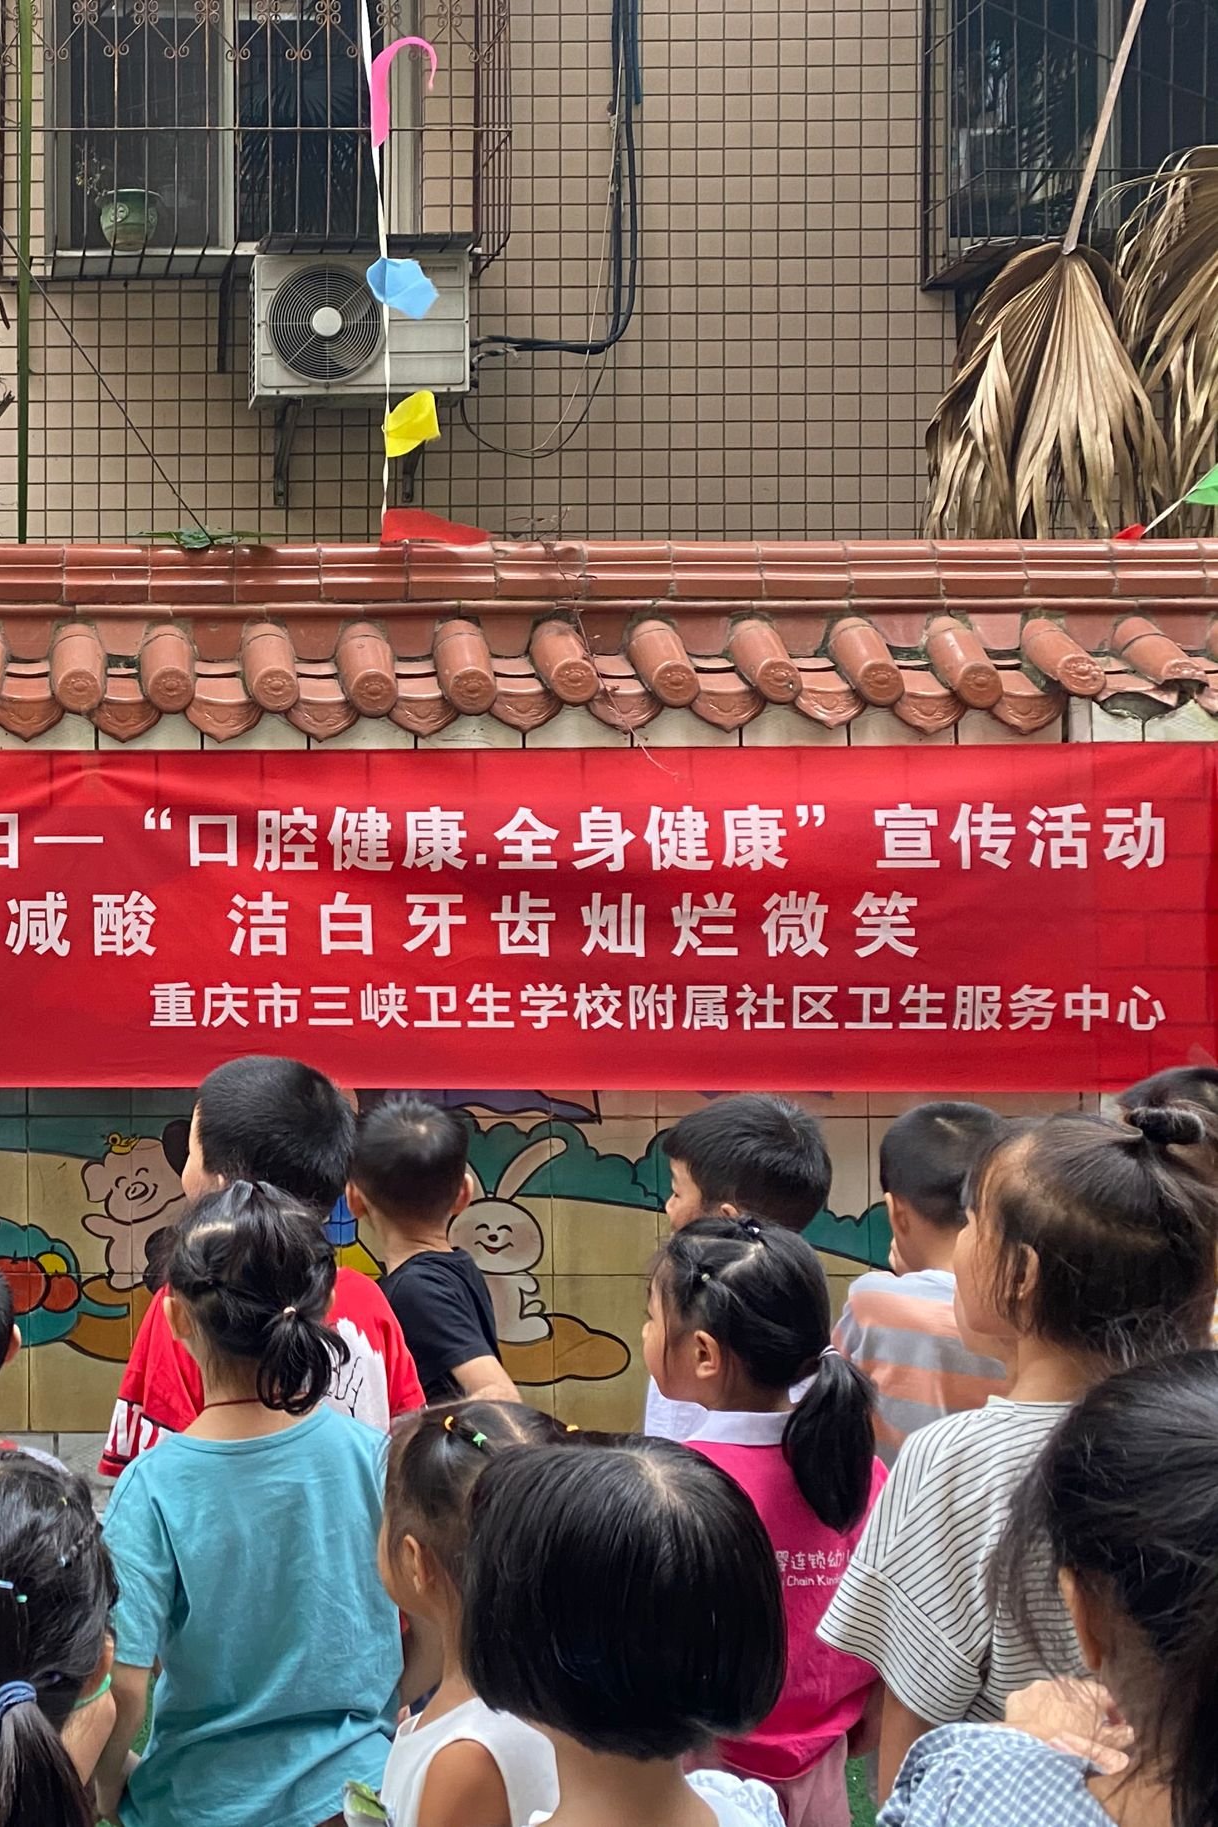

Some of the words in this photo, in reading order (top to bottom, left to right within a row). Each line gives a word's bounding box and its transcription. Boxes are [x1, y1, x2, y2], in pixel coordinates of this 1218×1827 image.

[228, 891, 919, 958] 洁白牙齿灿烂微笑
[149, 982, 1166, 1031] 重庆市三峡卫生学校附属社区卫生服务中心
[786, 1575, 815, 1587] Chain
